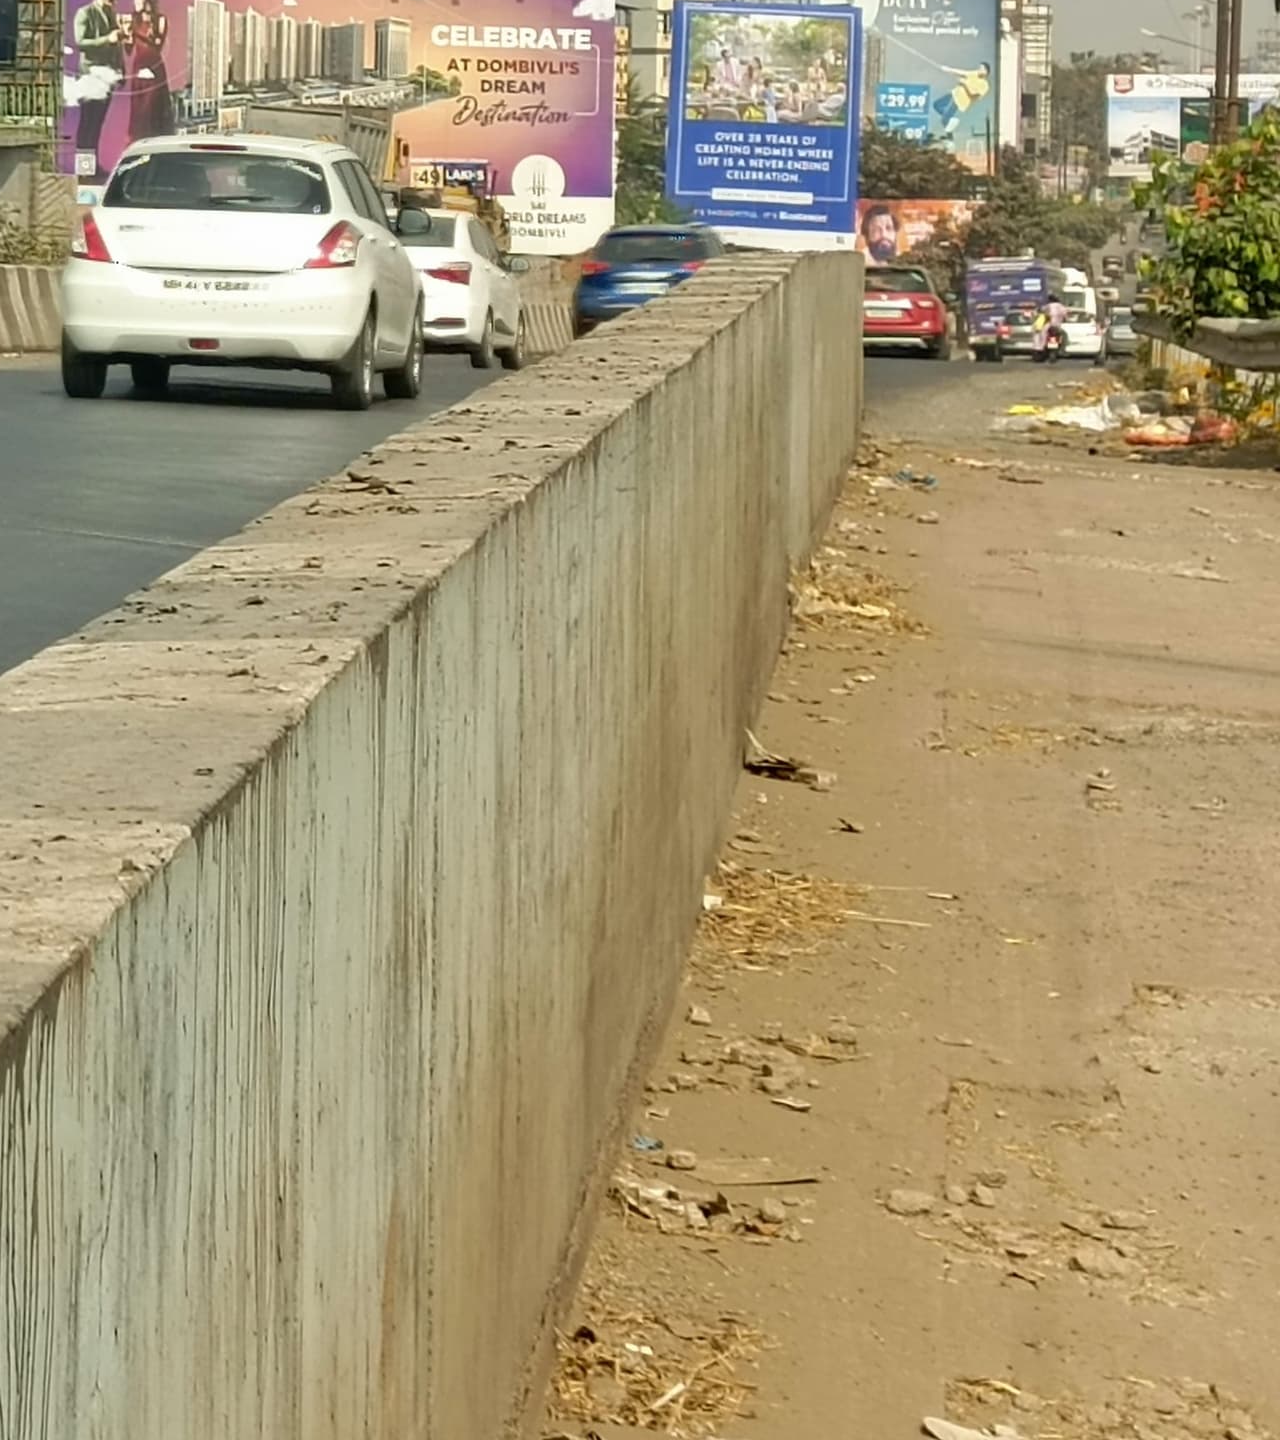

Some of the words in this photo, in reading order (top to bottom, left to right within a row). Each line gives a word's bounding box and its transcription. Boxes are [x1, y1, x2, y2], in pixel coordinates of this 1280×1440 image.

[431, 24, 592, 50] CELEBRATE
[447, 58, 472, 72] AT
[476, 59, 580, 75] DOMBIVLI'S
[481, 80, 546, 94] DREAM
[452, 95, 570, 127] Destination
[714, 131, 744, 142] OVER
[765, 134, 798, 145] YEARS
[802, 136, 817, 146] OF
[695, 143, 751, 155] CREATING
[754, 145, 794, 157] HOMES
[797, 148, 834, 160] WHERE
[697, 156, 720, 167] LIFE
[723, 157, 734, 168] IS
[737, 158, 746, 168] A
[537, 212, 587, 225] DREAMS
